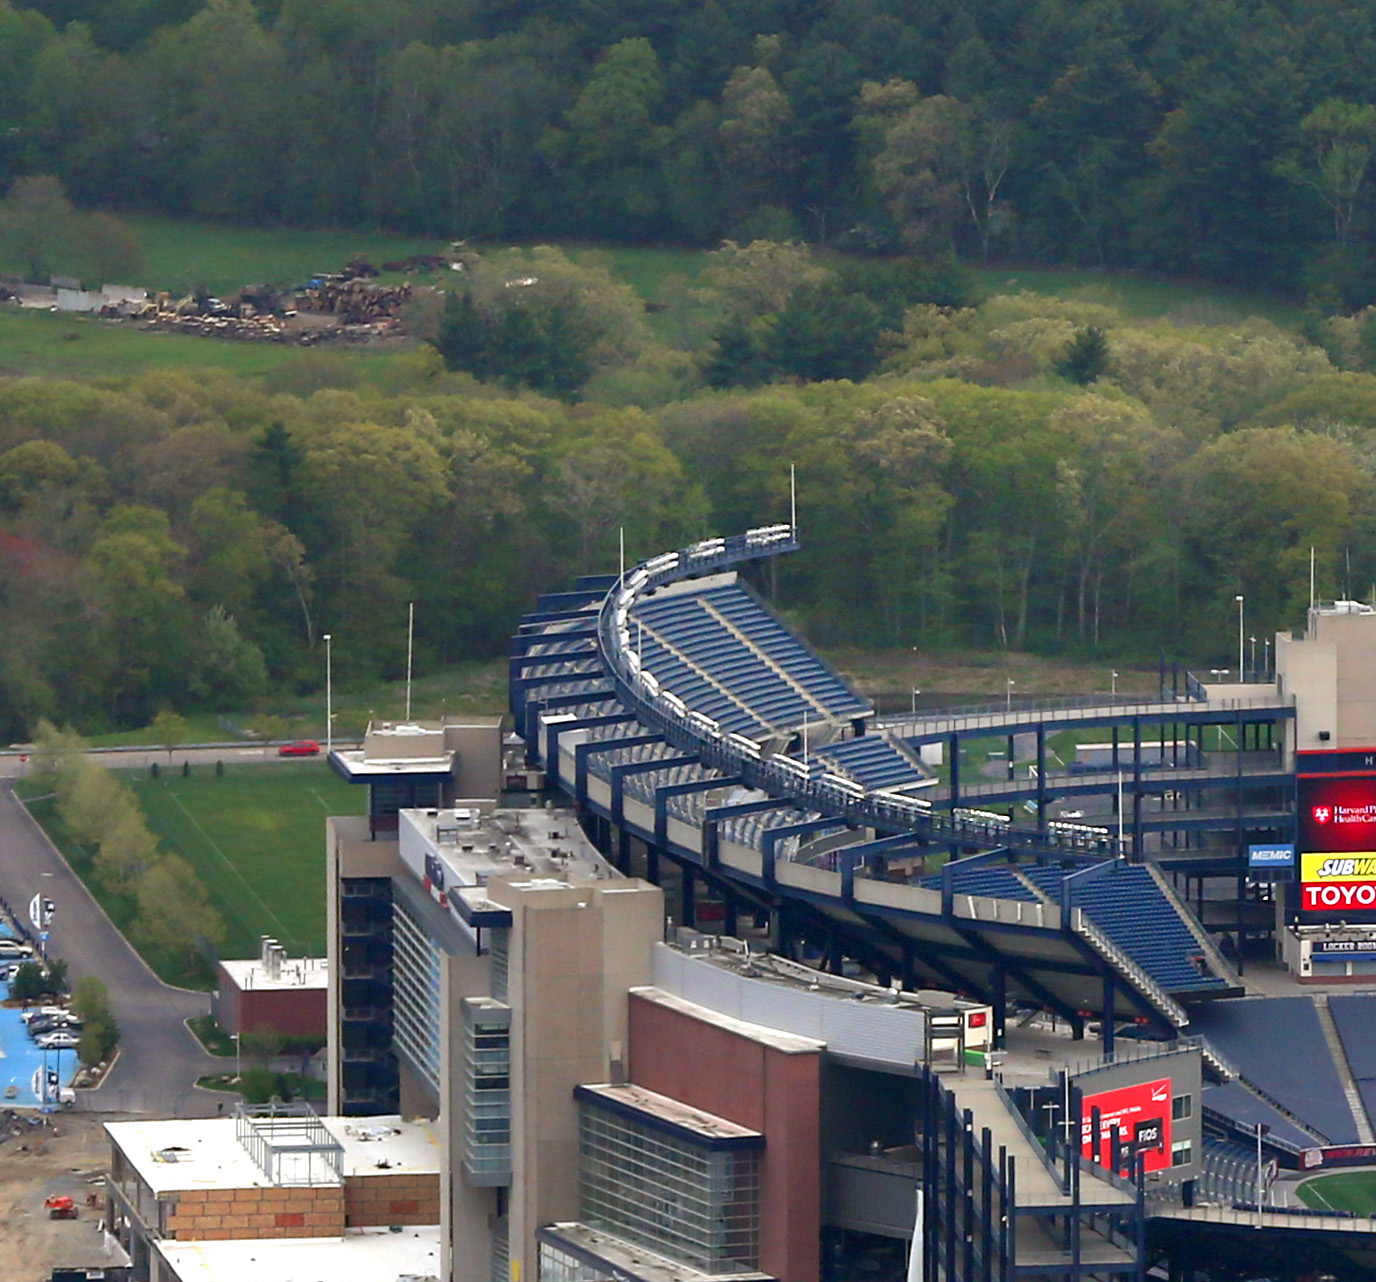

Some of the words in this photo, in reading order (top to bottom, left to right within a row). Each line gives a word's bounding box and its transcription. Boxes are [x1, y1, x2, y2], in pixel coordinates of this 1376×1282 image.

[1334, 806, 1369, 815] Harvard
[1251, 850, 1292, 860] MEMIC
[1323, 941, 1353, 951] LOCKER
